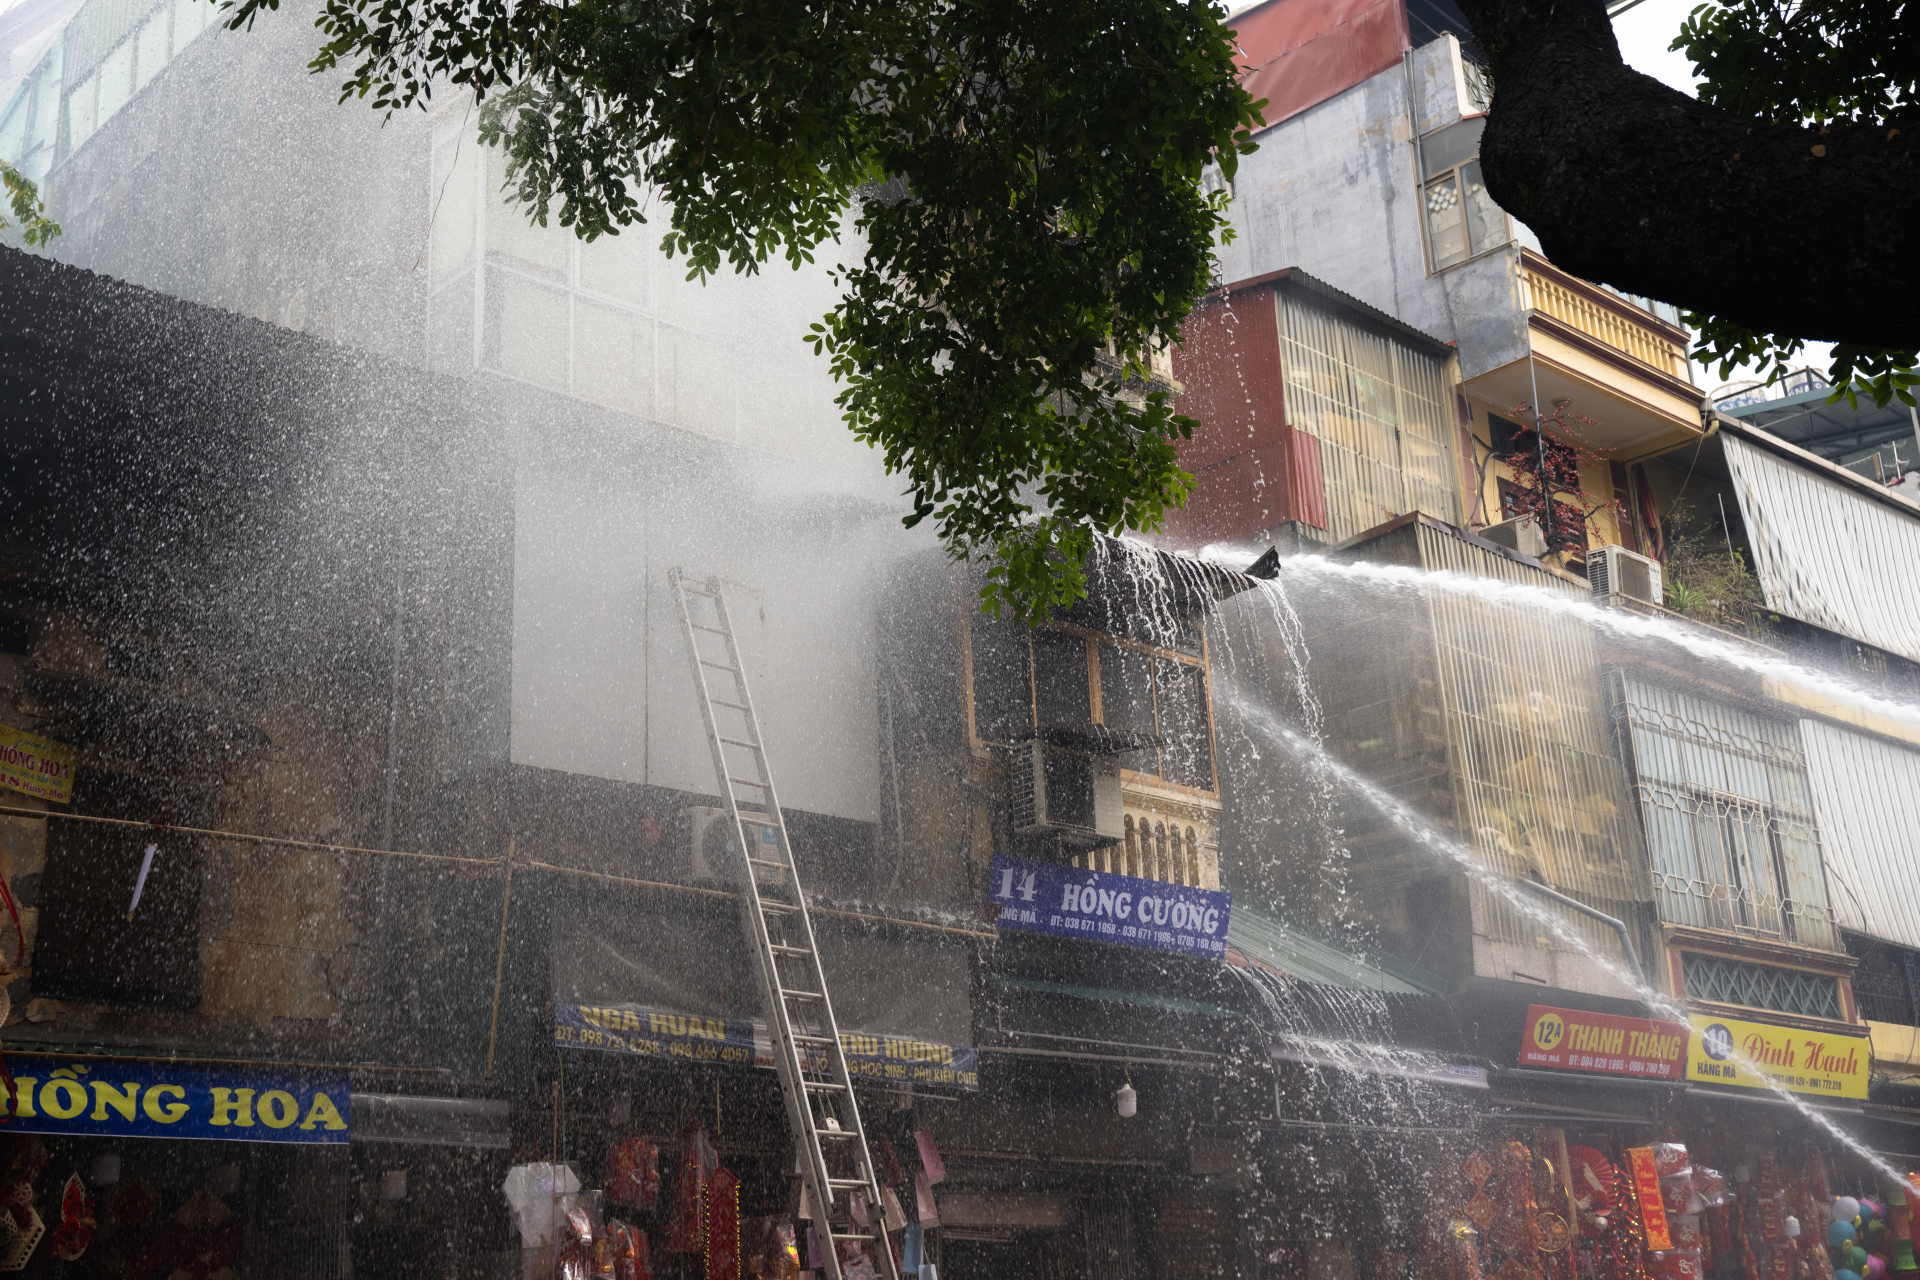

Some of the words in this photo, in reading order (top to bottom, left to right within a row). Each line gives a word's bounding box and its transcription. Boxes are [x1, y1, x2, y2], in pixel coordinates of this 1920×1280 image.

[39, 758, 69, 780] HOA
[995, 867, 1038, 901] 14
[1061, 873, 1131, 919] HỒNG
[1138, 894, 1219, 934] CƯỜNG
[1050, 915, 1063, 927] ĐT:
[1065, 917, 1080, 930] 038
[1081, 919, 1095, 932] 671
[1098, 922, 1116, 935] 1958
[1122, 925, 1136, 937] 038
[1138, 928, 1151, 940] 671
[1177, 935, 1194, 947] 0705
[1197, 938, 1209, 949] 168
[556, 1025, 576, 1040] ĐT:
[579, 1028, 603, 1045] 098
[669, 1041, 691, 1057] 098
[838, 1033, 878, 1056] THU
[1538, 1020, 1562, 1044] 12A
[1567, 1024, 1625, 1055] THANH
[1628, 1025, 1681, 1061] THẮNG
[1708, 1028, 1729, 1057] 10
[1568, 1054, 1579, 1066] ĐT:
[1581, 1056, 1593, 1067] 084
[1594, 1057, 1607, 1069] 820
[1608, 1059, 1624, 1070] 1995
[1629, 1060, 1645, 1072] 0984
[1697, 1059, 1721, 1076] HÀNG
[1722, 1063, 1736, 1079] MÃ
[1804, 1040, 1859, 1078] Hạnh
[885, 1064, 907, 1079] SINH
[957, 1070, 977, 1085] CUTE
[1822, 1079, 1831, 1089] 772
[208, 1086, 348, 1131] HOA
